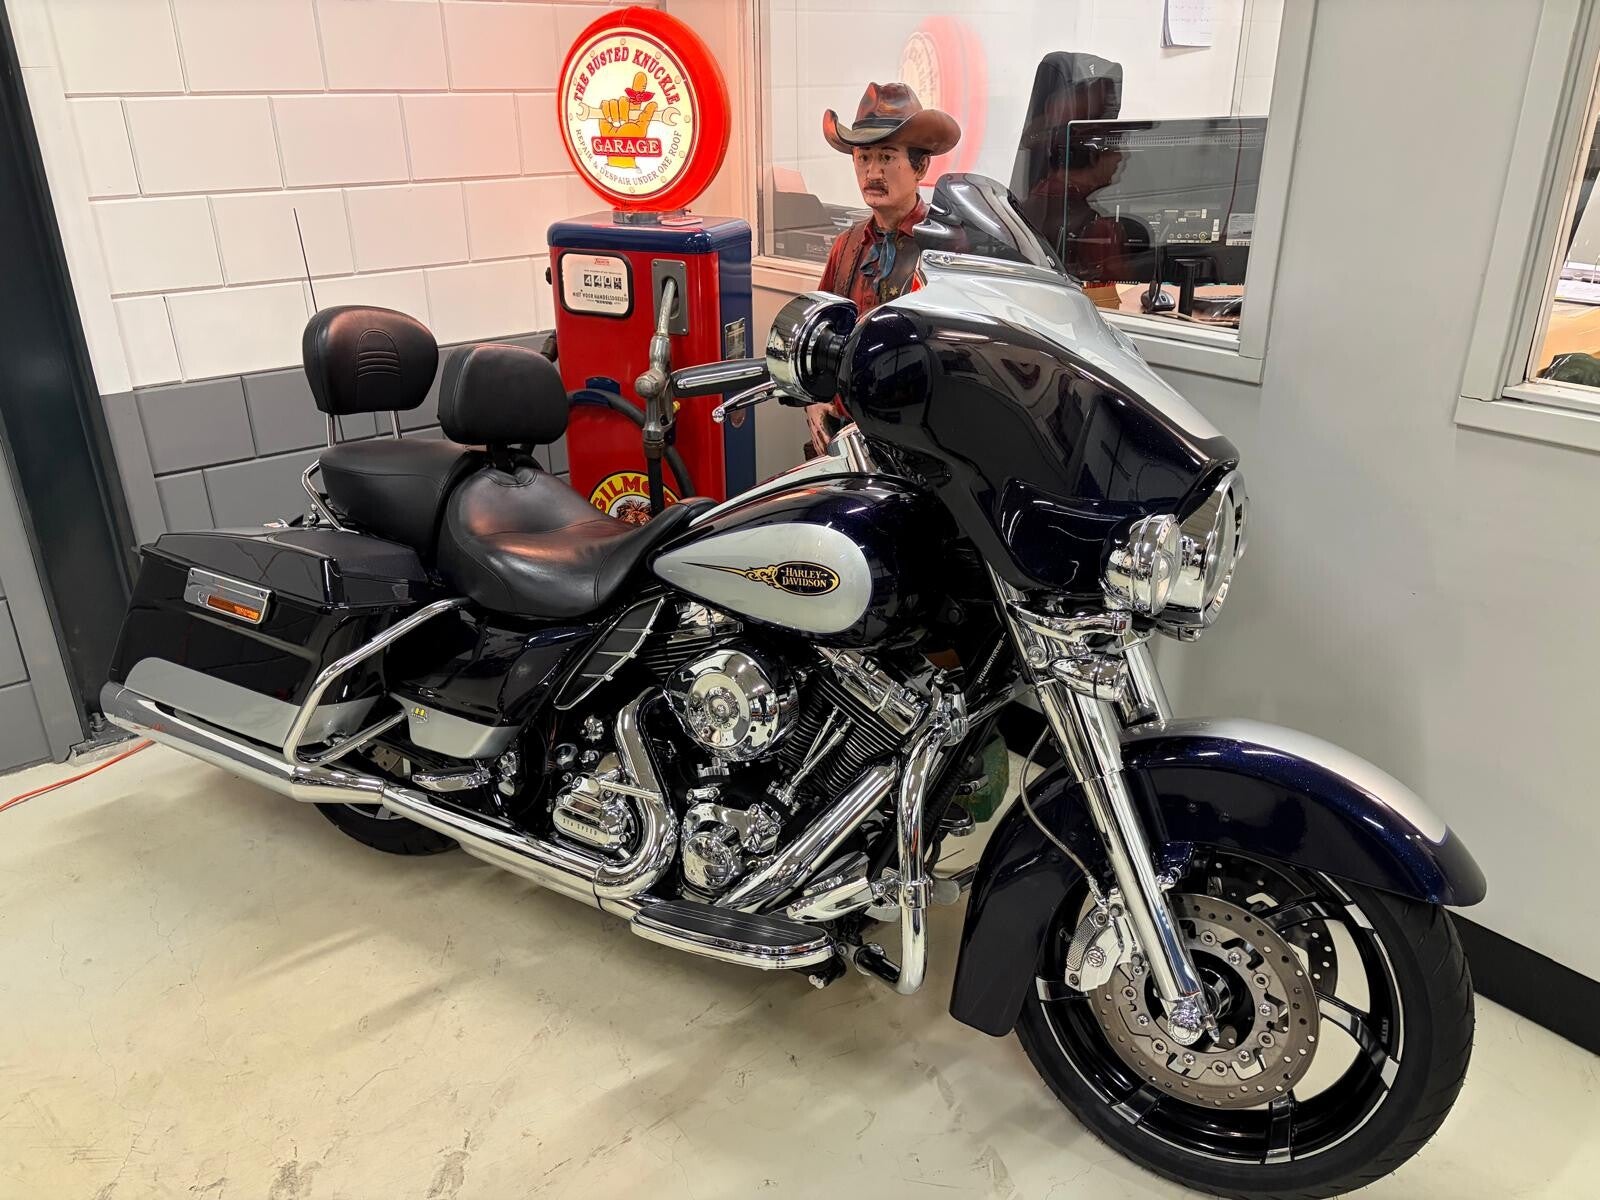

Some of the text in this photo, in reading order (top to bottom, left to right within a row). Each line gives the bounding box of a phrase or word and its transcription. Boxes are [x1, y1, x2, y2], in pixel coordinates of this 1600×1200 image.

[574, 46, 681, 105] THE BUSTED KNUCKLE
[575, 128, 593, 162] REPAIR
[599, 166, 632, 186] DESPAIR
[632, 171, 661, 186] UNDER
[657, 158, 673, 174] ONE
[668, 130, 683, 157] ROOF
[592, 138, 660, 154] GARAGE
[782, 576, 827, 588] DAVIDSON
